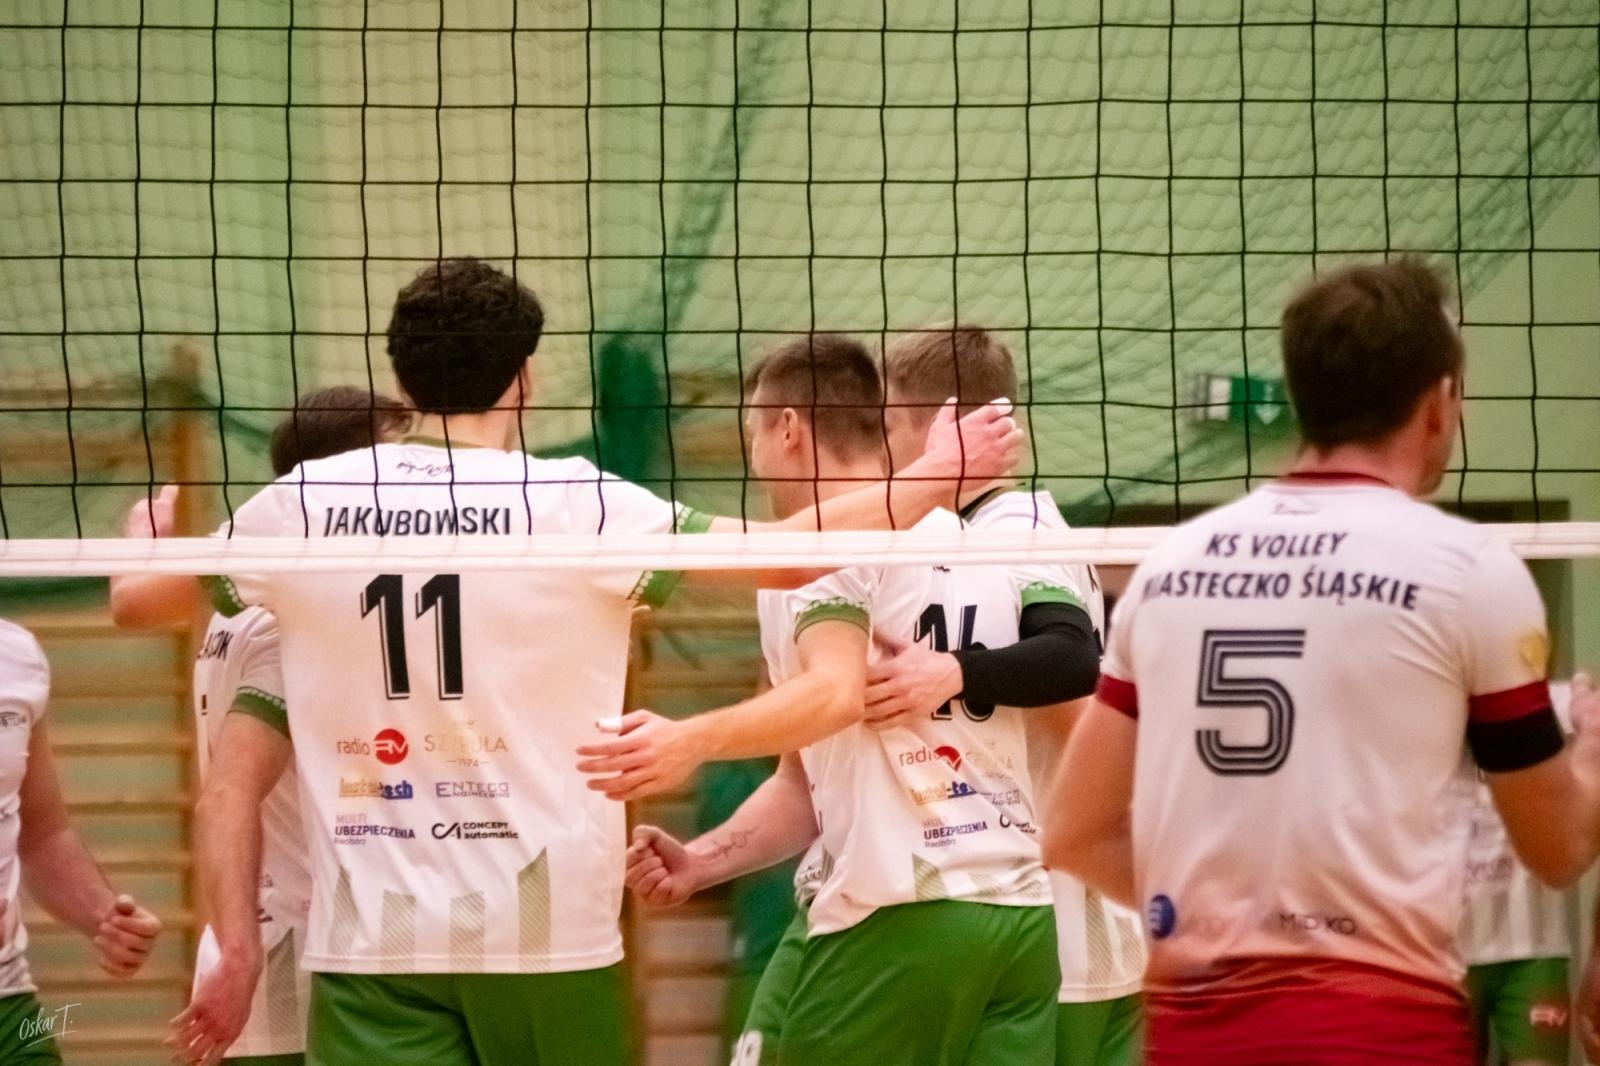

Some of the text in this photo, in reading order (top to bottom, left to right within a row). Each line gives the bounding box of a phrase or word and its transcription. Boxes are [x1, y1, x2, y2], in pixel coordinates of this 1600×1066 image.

[1205, 532, 1347, 558] KS VOLLEY
[1300, 565, 1420, 611] ŚLĄSKIE
[360, 573, 464, 701] 11
[1195, 629, 1306, 776] 5
[336, 738, 370, 755] radio
[435, 781, 509, 798] ENTECO
[335, 825, 416, 839] UBEZPIECZENIA
[463, 822, 508, 830] CONCEPT
[464, 831, 519, 840] automatic
